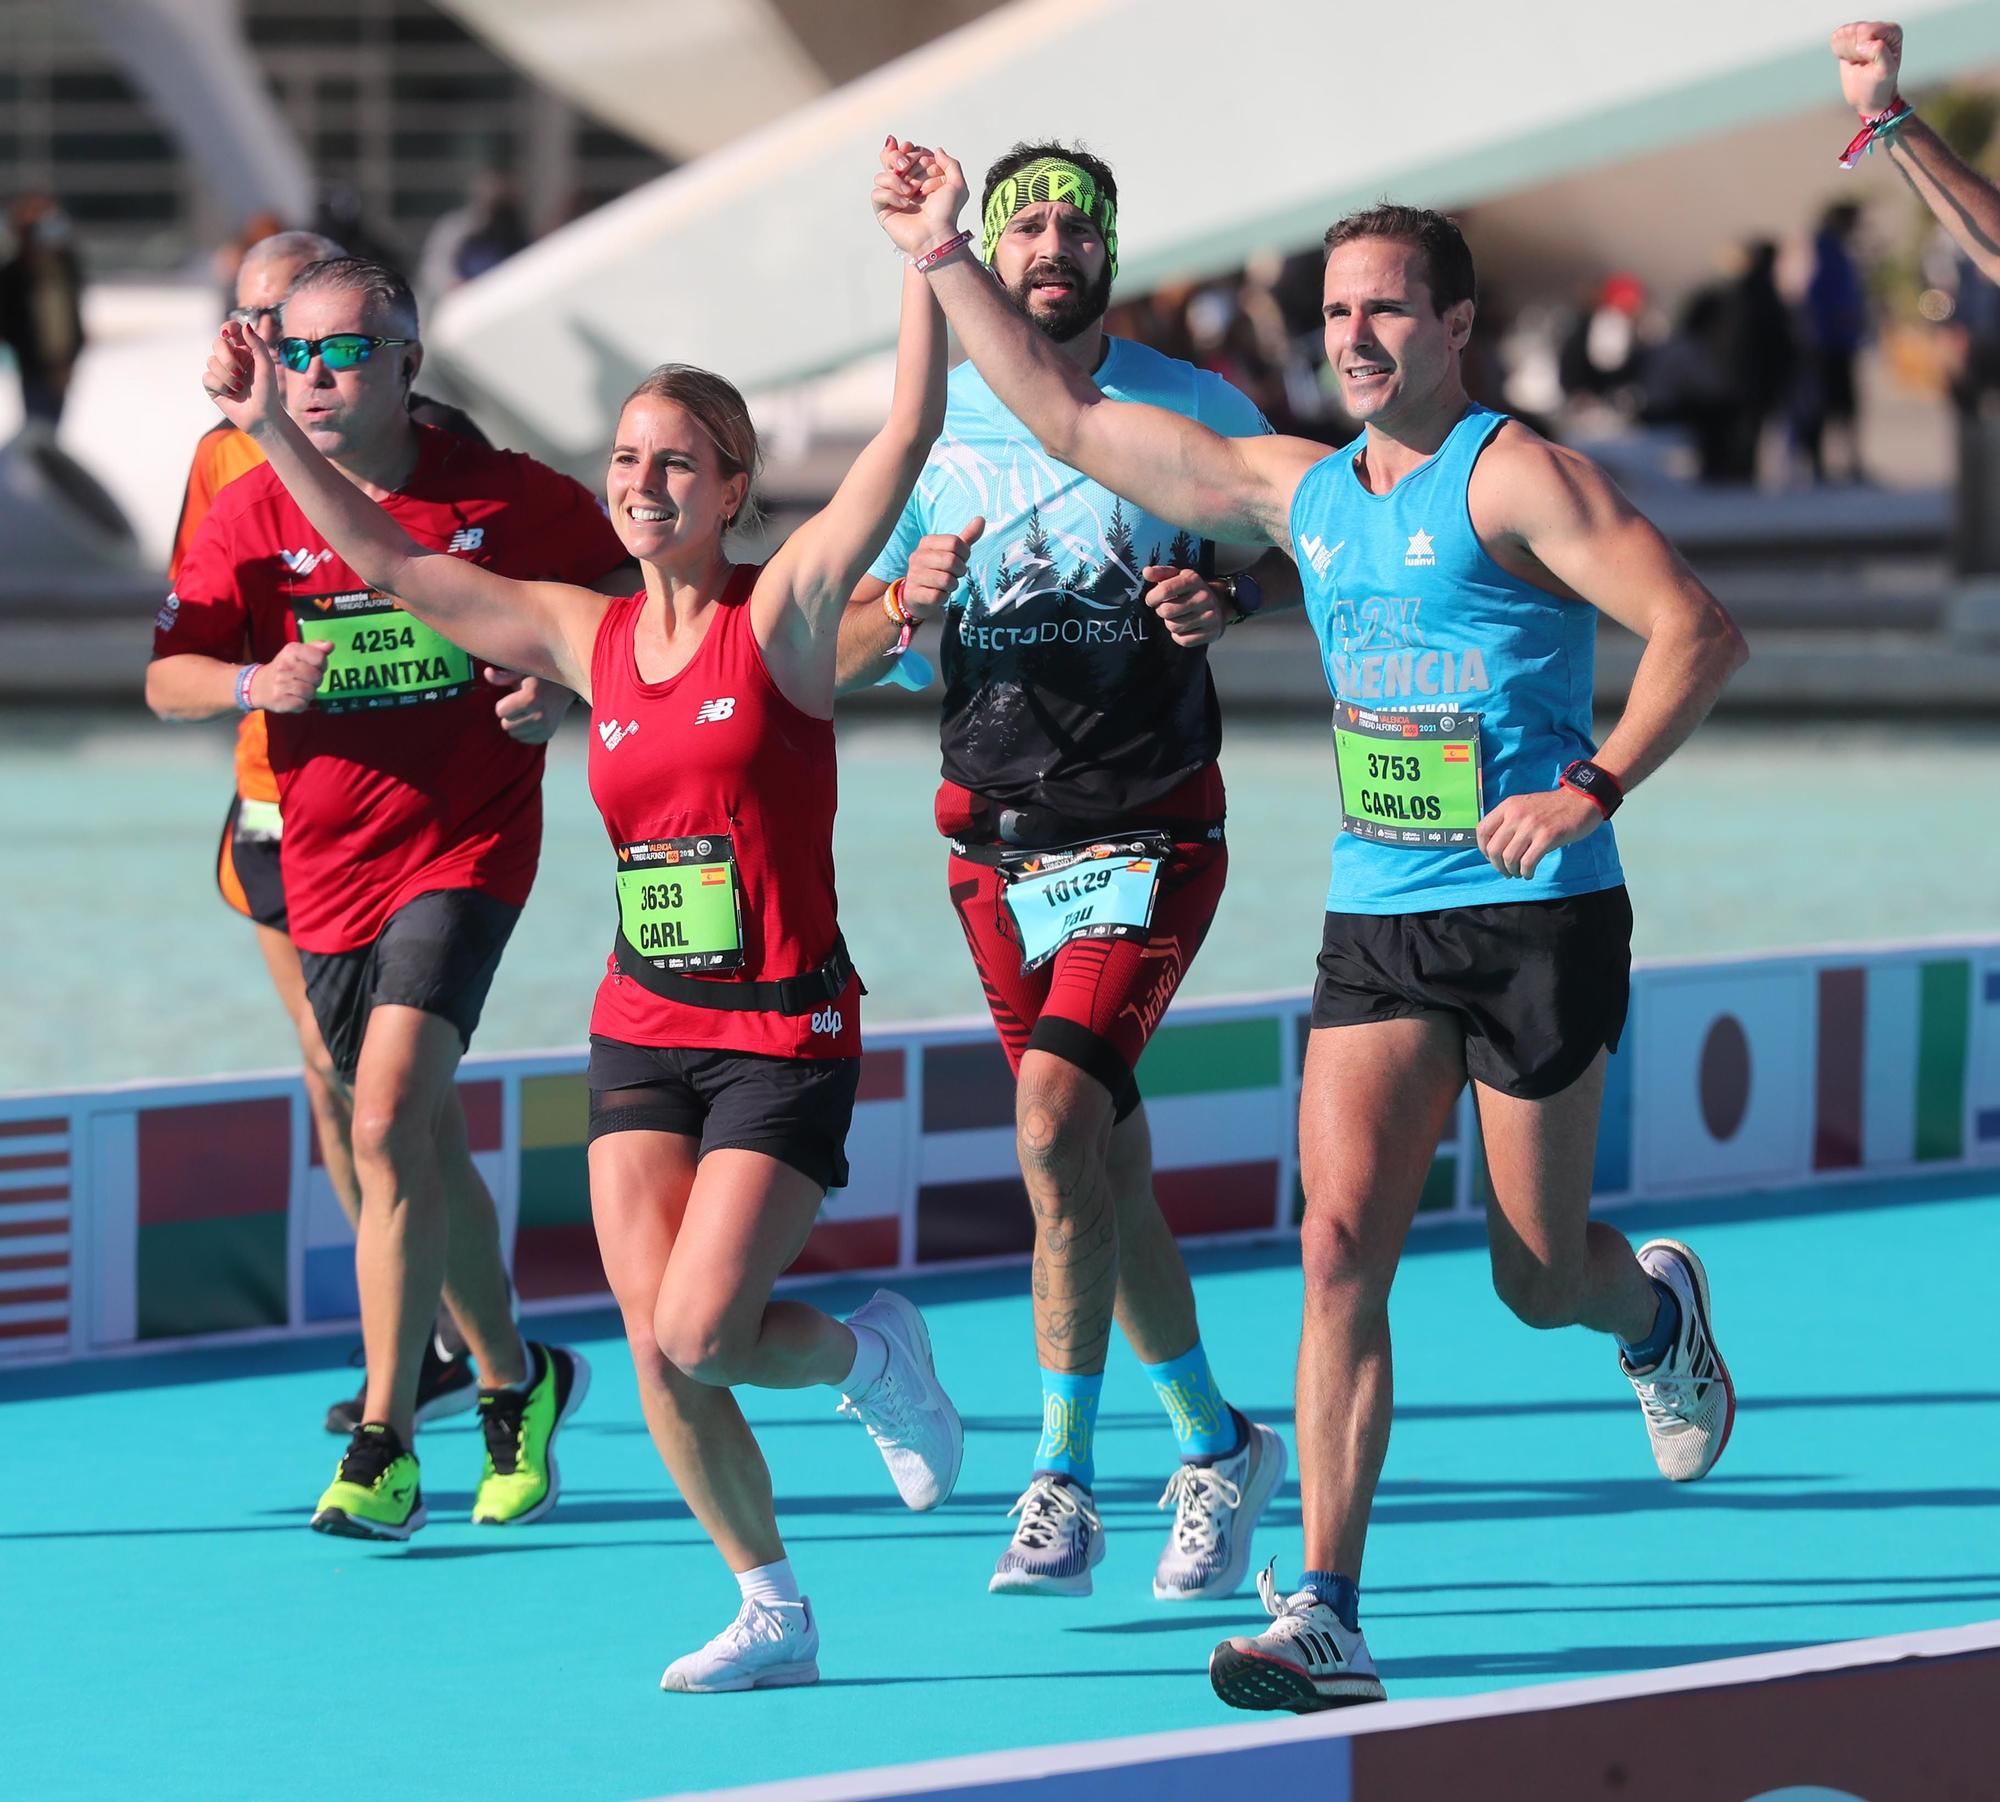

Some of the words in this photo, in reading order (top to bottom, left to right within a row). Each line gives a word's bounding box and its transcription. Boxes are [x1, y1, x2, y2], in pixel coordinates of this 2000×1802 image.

[447, 527, 485, 553] NB
[351, 627, 415, 653] 4254
[328, 656, 450, 692] ARANTXA
[694, 697, 736, 726] NB
[1367, 753, 1421, 782] 3753
[1361, 789, 1442, 821] CARLOS
[641, 883, 684, 911] 3633
[1041, 869, 1112, 908] 10129
[640, 921, 690, 950] CARL
[811, 1005, 843, 1039] edp
